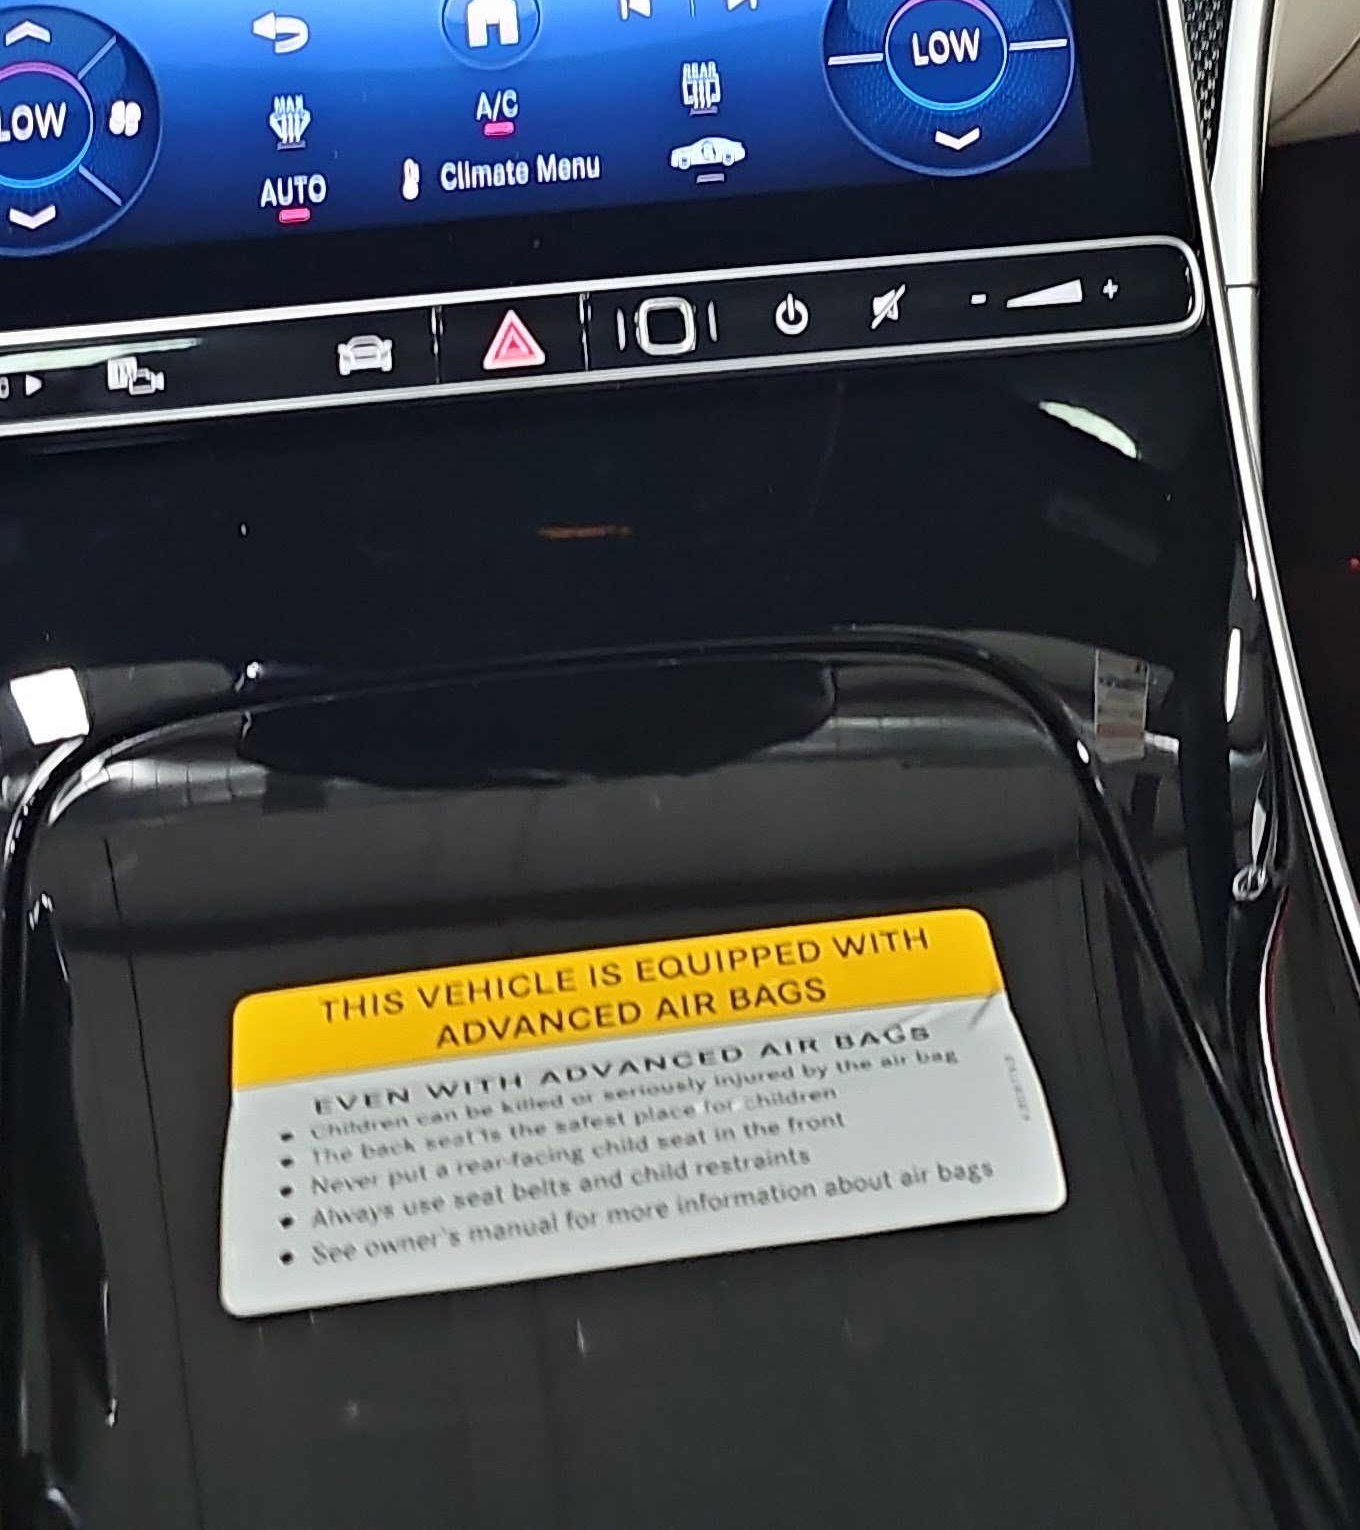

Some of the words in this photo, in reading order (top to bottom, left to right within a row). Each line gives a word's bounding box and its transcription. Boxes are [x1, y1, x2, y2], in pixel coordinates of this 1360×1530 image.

[910, 28, 981, 67] LOW
[476, 89, 519, 122] A/C
[260, 173, 327, 208] AUTO
[440, 160, 529, 192] Climate
[536, 151, 601, 184] Menu
[320, 989, 405, 1024] THIS
[416, 967, 576, 1009] VEHICLE
[589, 963, 622, 988] IS
[636, 938, 821, 983] EQUIPPED
[832, 926, 930, 959] WITH
[436, 1000, 641, 1049] ADVANCED
[656, 991, 717, 1021] AIR
[729, 976, 827, 1012] BAGS
[311, 1115, 409, 1140] Children
[417, 1109, 458, 1127] can
[465, 1101, 493, 1119] be
[501, 1094, 563, 1115] killed
[571, 1091, 593, 1105] or
[603, 1074, 706, 1101] seriously
[714, 1064, 795, 1089] injured
[802, 1061, 828, 1081] by
[836, 1054, 873, 1073] the
[880, 1052, 907, 1068] air
[915, 1047, 960, 1068] bag
[313, 1087, 410, 1115] EVEN
[427, 1072, 522, 1099] WITH
[540, 1047, 743, 1085] ADVANCED
[759, 1037, 819, 1059] AIR
[835, 1025, 930, 1050] BAGS
[311, 1146, 353, 1167] The
[361, 1138, 416, 1160] back
[425, 1130, 474, 1150] seat
[483, 1126, 503, 1144] is
[510, 1121, 546, 1140] the
[555, 1110, 625, 1135] safest
[633, 1102, 696, 1128] place
[703, 1098, 736, 1116] for
[745, 1087, 838, 1113] children
[311, 1172, 378, 1197] Never
[389, 1164, 428, 1189] put
[435, 1164, 449, 1180] a
[456, 1144, 585, 1175] rear-facing
[591, 1134, 649, 1160] child
[657, 1130, 707, 1151] seat
[714, 1125, 736, 1142] in
[742, 1120, 781, 1139] the
[787, 1111, 846, 1134] front
[311, 1201, 395, 1230] Always
[401, 1194, 446, 1217] use
[453, 1185, 505, 1210] seat
[511, 1176, 572, 1203] belts
[578, 1168, 624, 1193] and
[630, 1158, 689, 1187] child
[695, 1146, 811, 1177] restraints
[311, 1242, 358, 1266] See
[364, 1225, 462, 1258] owner's
[468, 1209, 559, 1243] manual
[566, 1207, 599, 1231] for
[606, 1201, 669, 1225] more
[676, 1179, 817, 1216] information
[825, 1169, 893, 1199] about
[900, 1168, 929, 1188] air
[936, 1160, 994, 1186] bags
